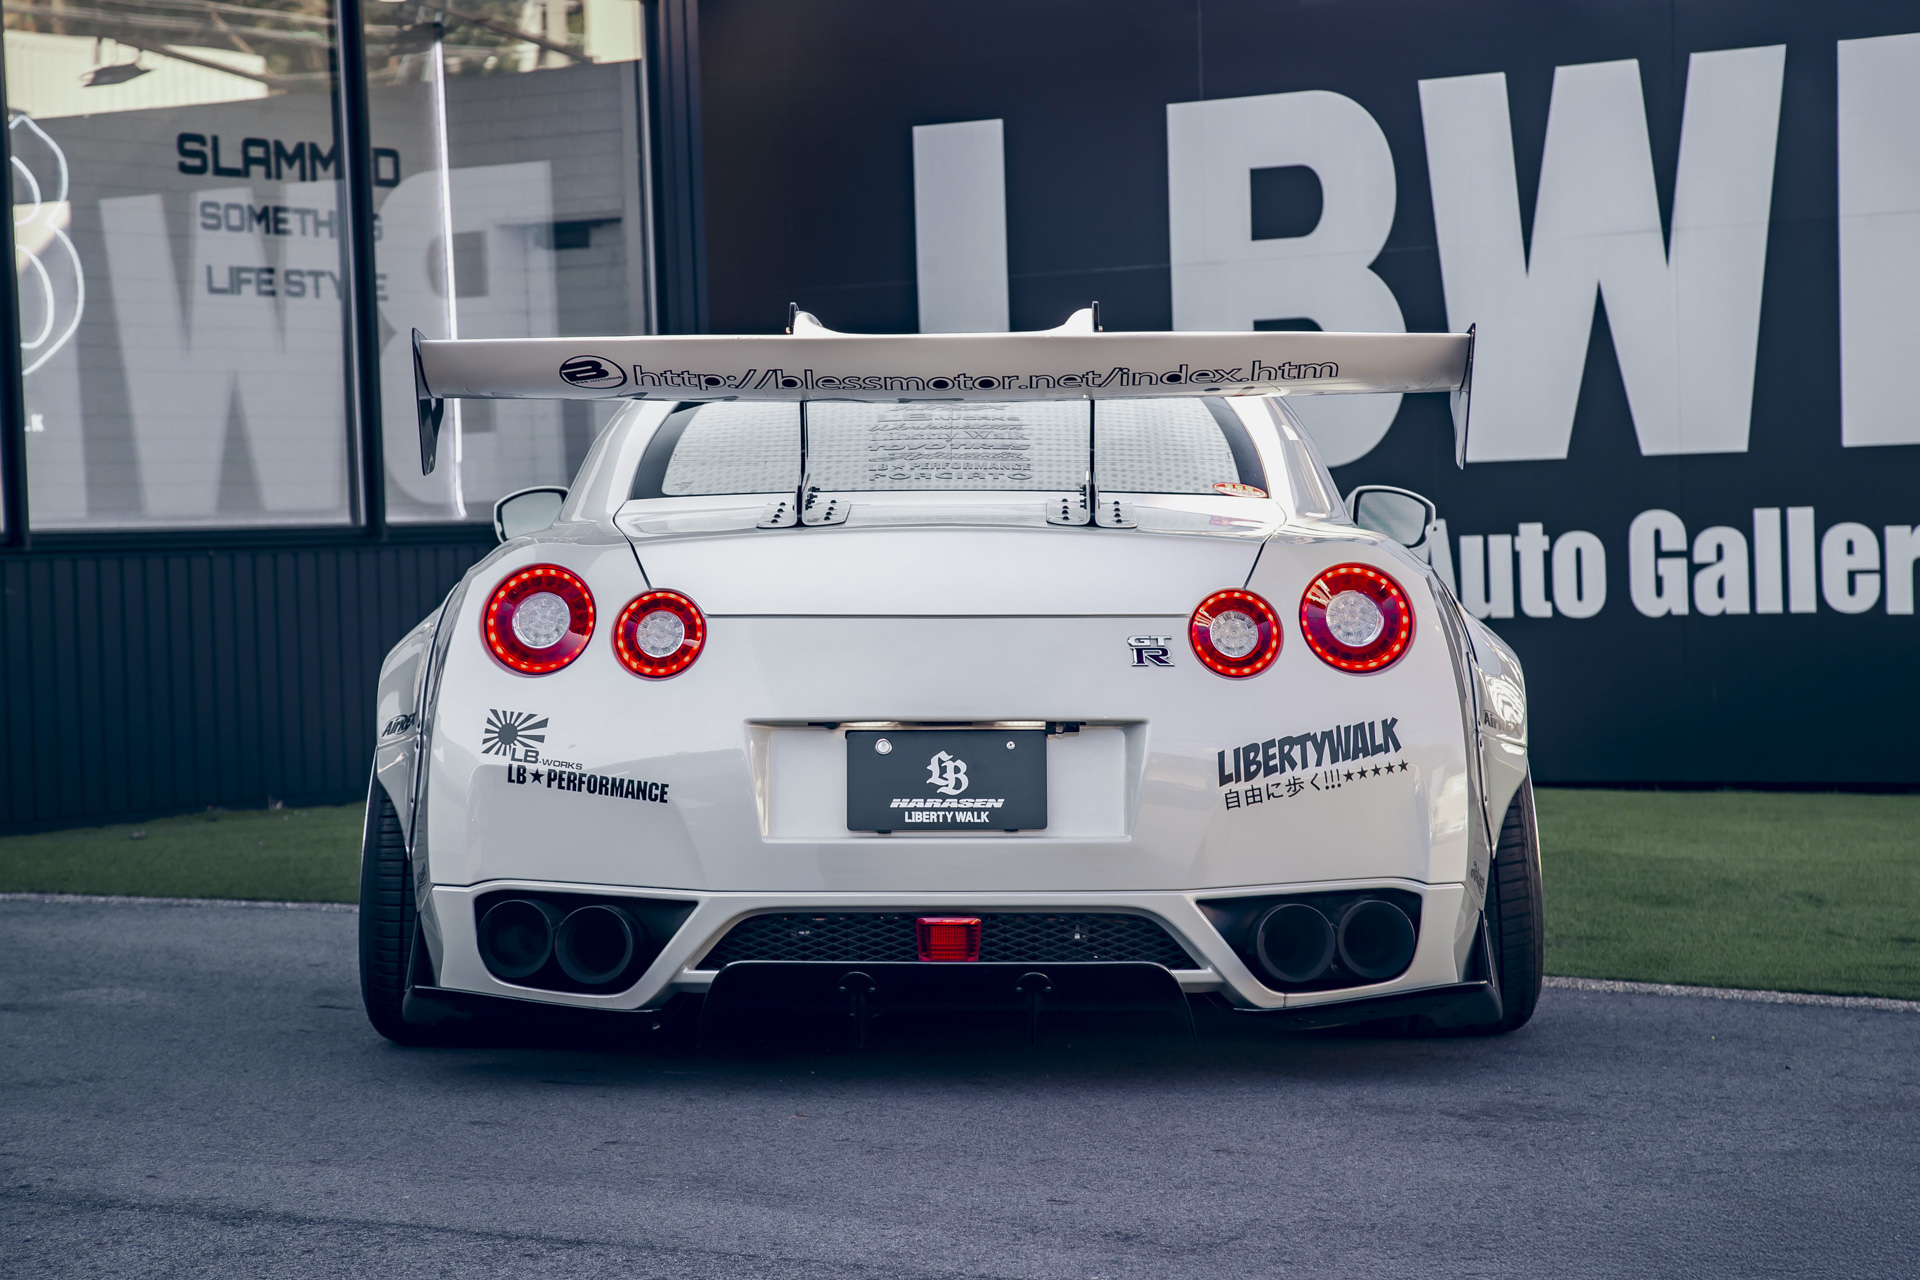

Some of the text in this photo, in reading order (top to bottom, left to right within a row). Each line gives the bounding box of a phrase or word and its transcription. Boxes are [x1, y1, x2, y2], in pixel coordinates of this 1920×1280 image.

[177, 132, 401, 188] SLAMMD
[206, 264, 278, 297] LIFE
[633, 360, 1339, 391] http://blessmotor.net/index.htm
[889, 798, 1005, 809] HARASEN
[904, 811, 990, 823] LIBERTY WALK
